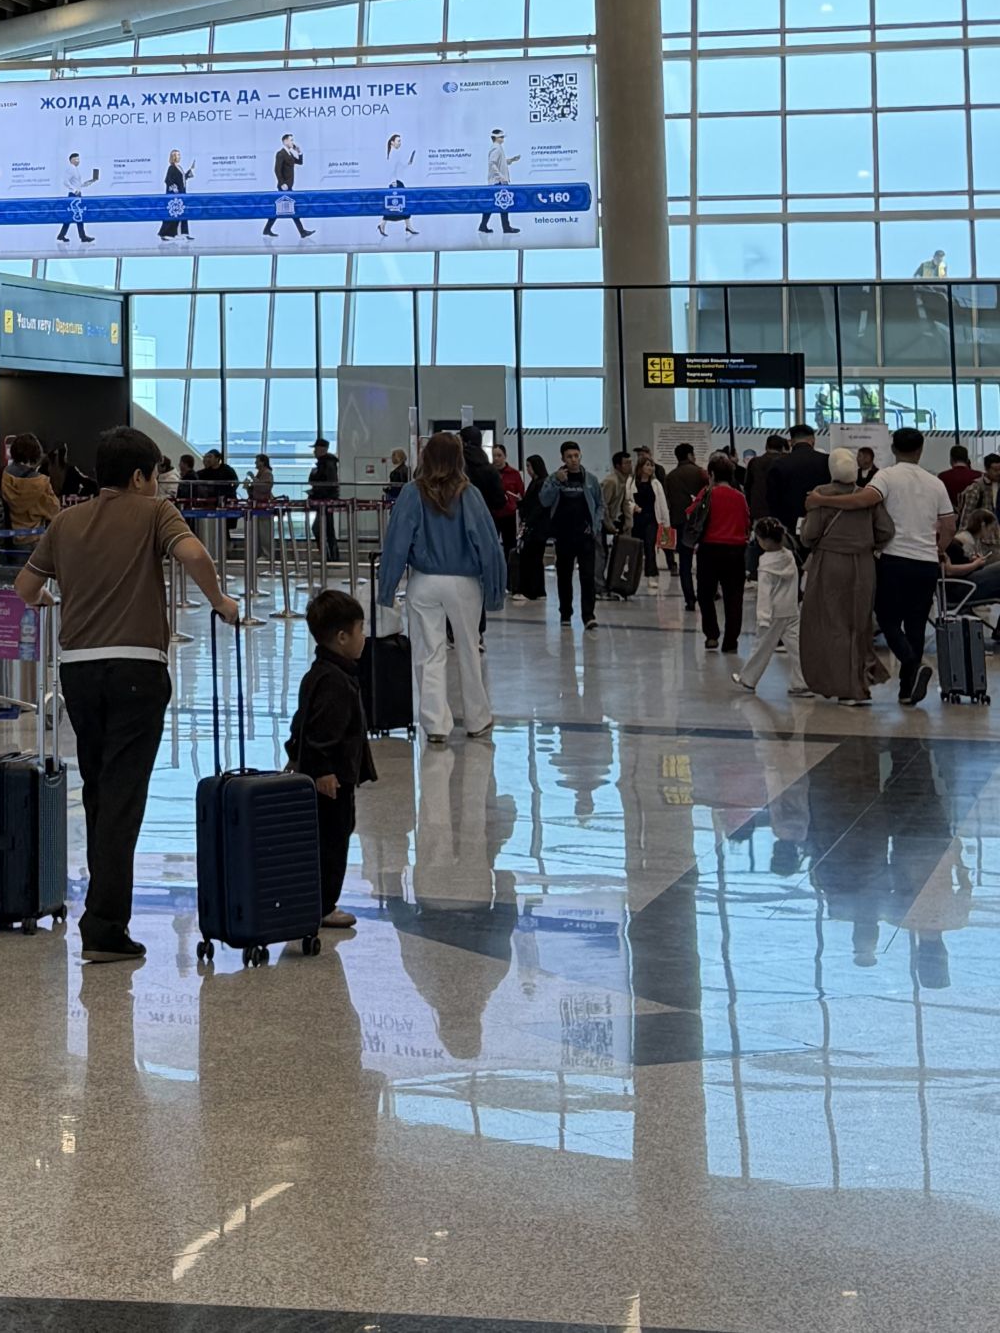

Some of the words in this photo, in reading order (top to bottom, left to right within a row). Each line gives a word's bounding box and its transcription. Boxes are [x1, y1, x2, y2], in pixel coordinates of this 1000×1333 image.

[40, 95, 102, 111] ЖОЛДА
[107, 94, 136, 109] ДА,
[141, 89, 231, 106] ЖҰМЫСТА
[237, 89, 260, 105] ДА
[288, 85, 361, 100] СЕНІМДІ
[367, 82, 417, 97] ТІРЕК
[65, 115, 74, 127] И
[79, 115, 88, 126] В
[91, 112, 149, 128] ДОРОГЕ,
[153, 112, 162, 123] И
[167, 111, 176, 123] В
[180, 109, 232, 123] РАБОТЕ
[255, 105, 336, 121] НАДЕЖНАЯ
[341, 103, 390, 117] ОПОРА
[548, 192, 570, 203] 160
[534, 216, 579, 224] telecom.kz
